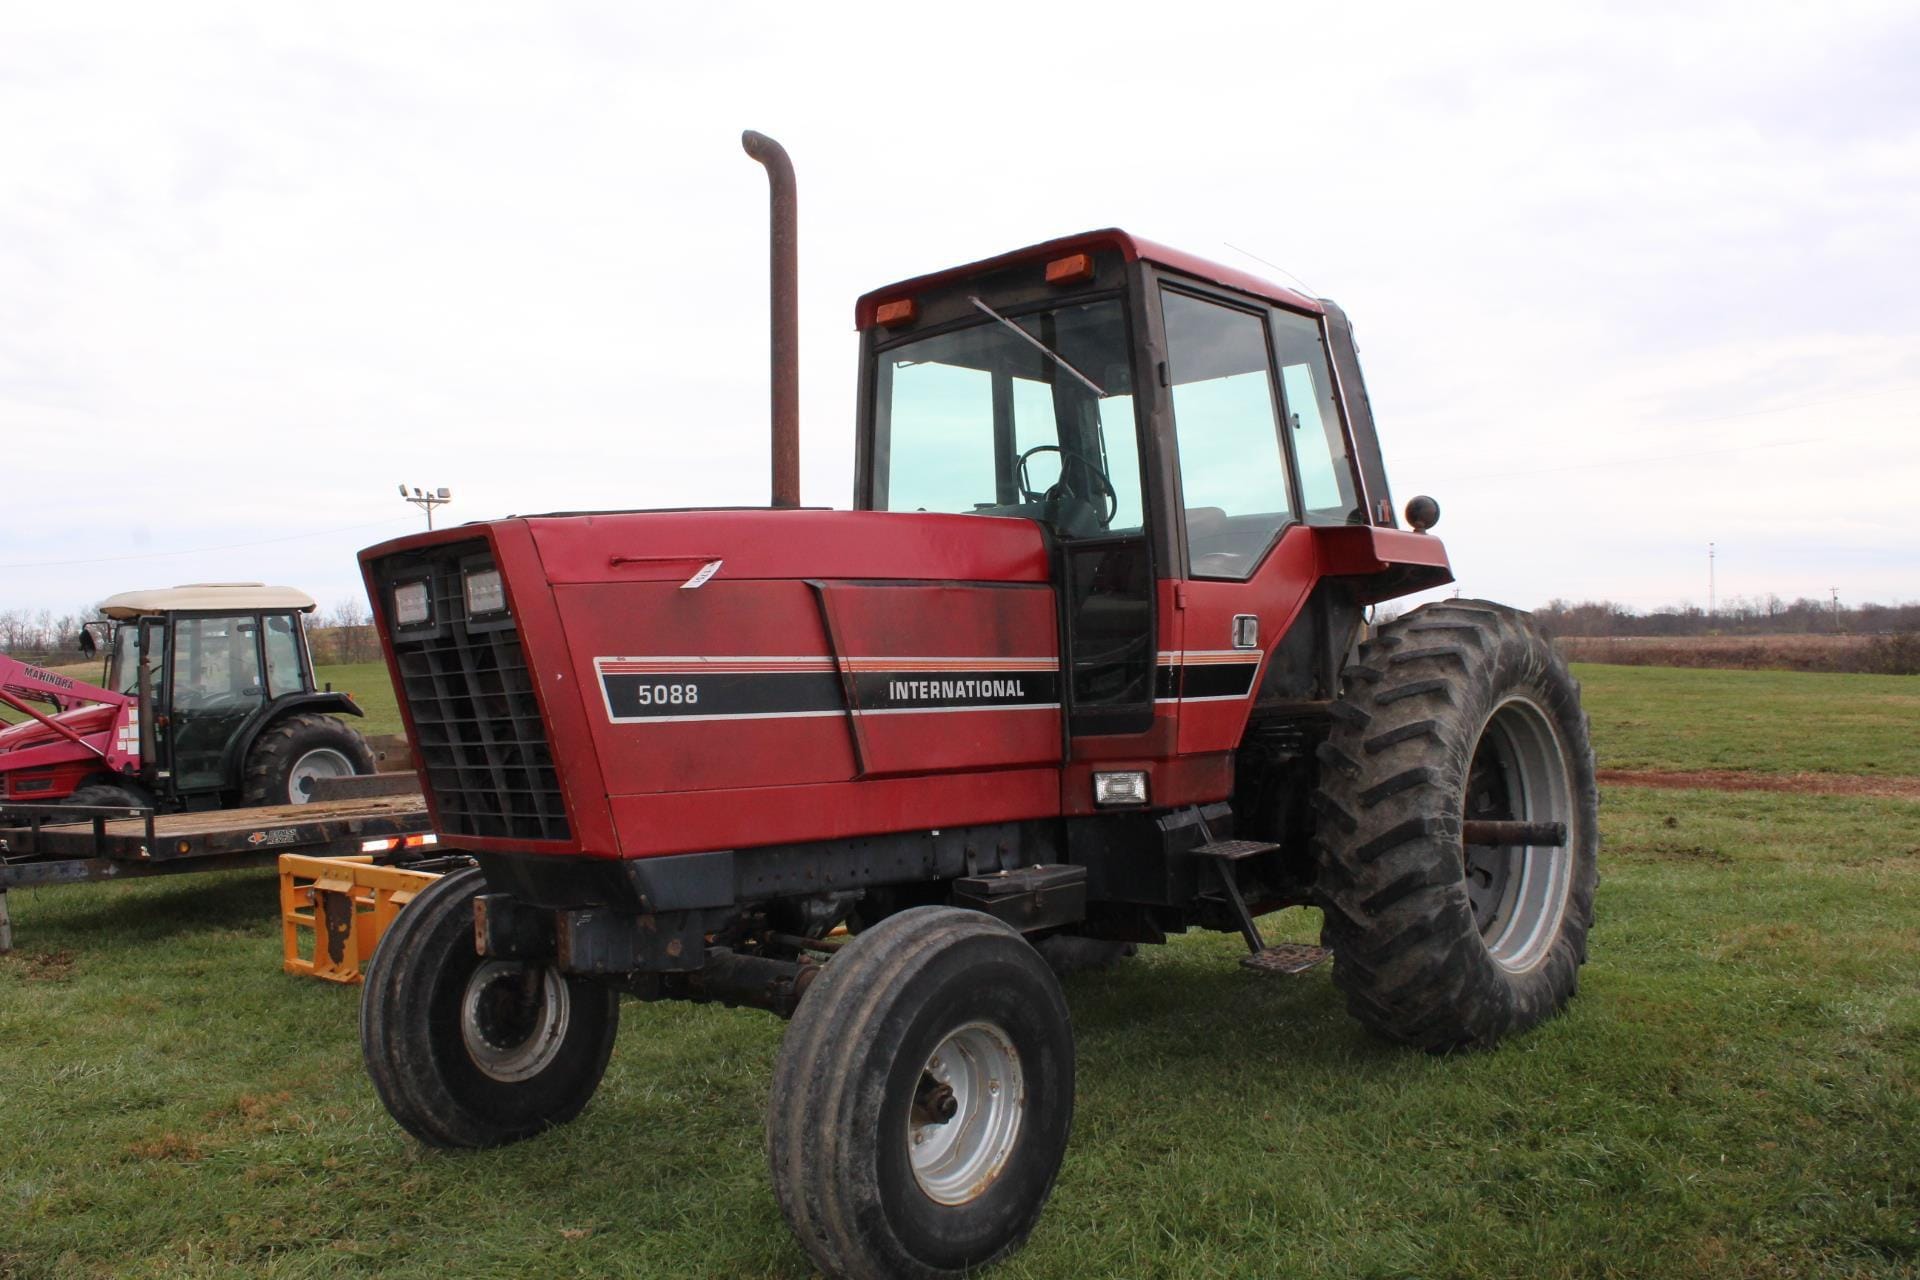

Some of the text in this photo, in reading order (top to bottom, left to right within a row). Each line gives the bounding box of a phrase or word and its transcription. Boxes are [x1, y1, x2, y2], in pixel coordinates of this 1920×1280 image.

[24, 667, 73, 689] MAHINDRA
[639, 684, 698, 705] 5088
[889, 680, 1025, 700] INTERNATIONAL
